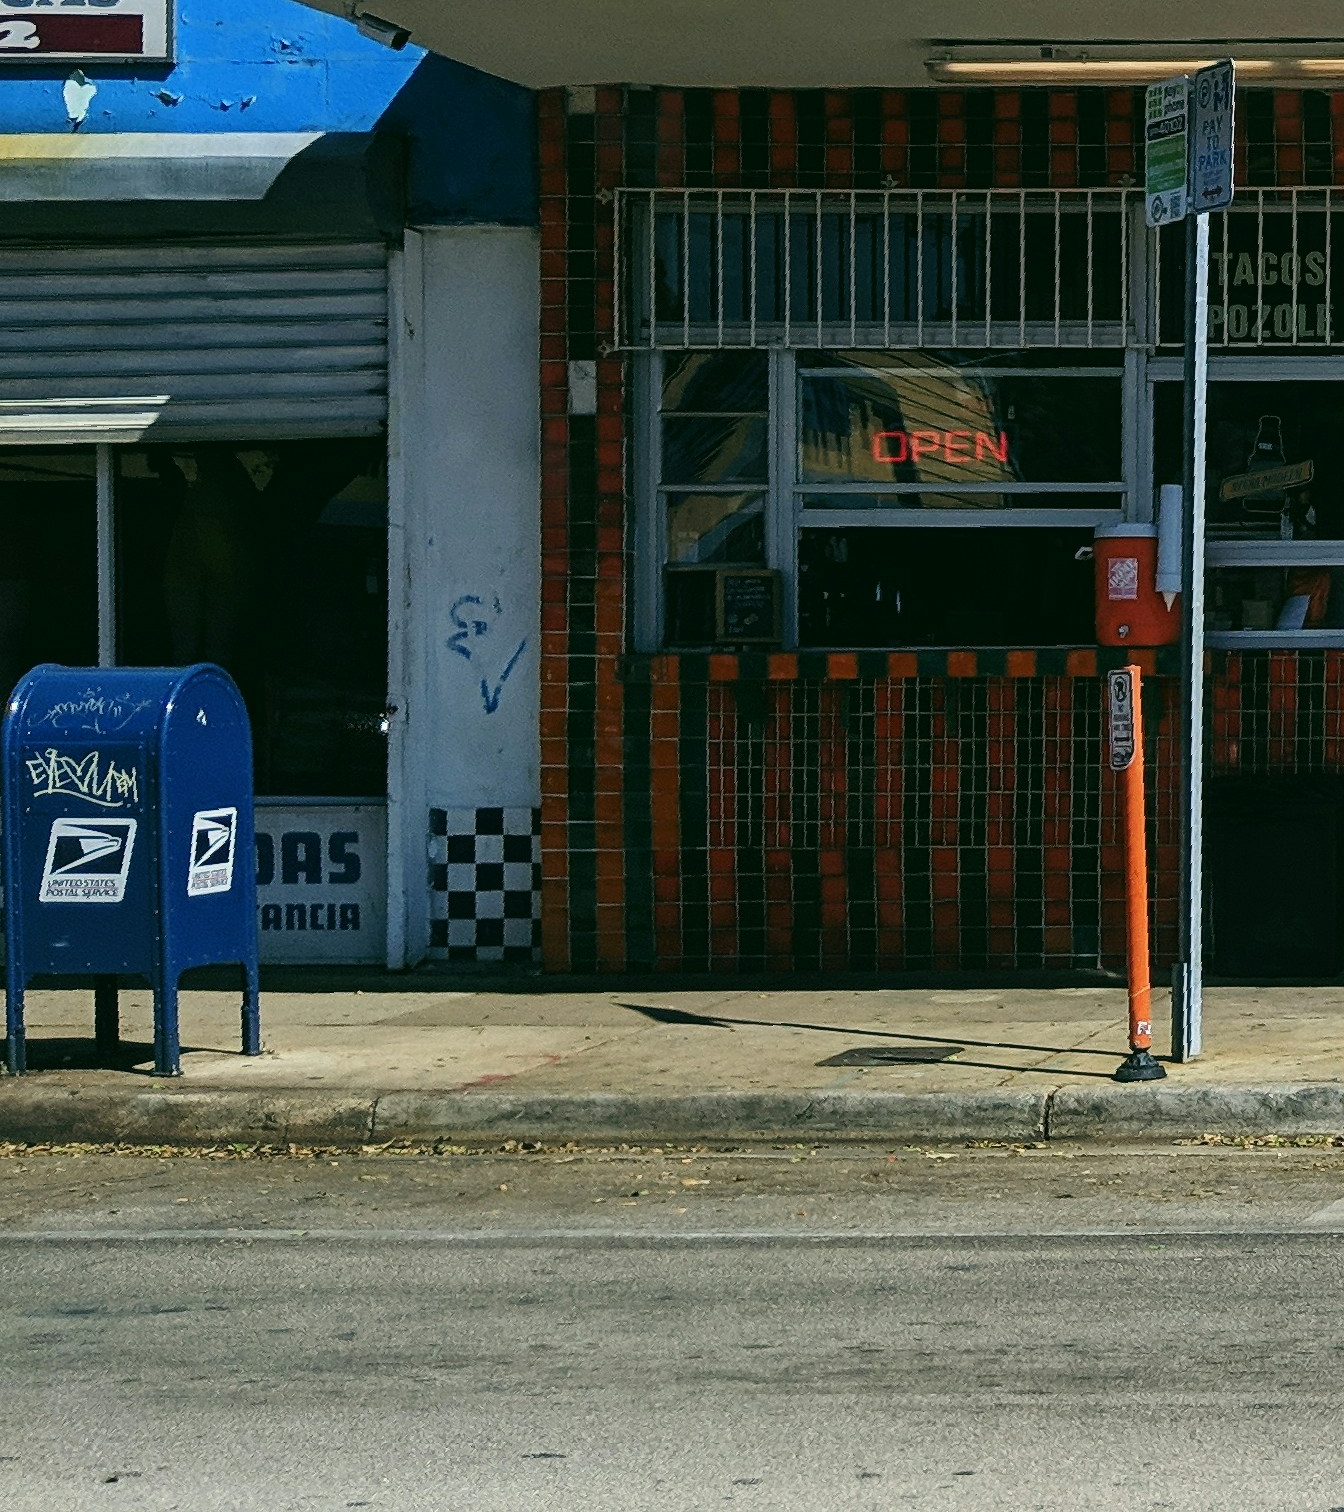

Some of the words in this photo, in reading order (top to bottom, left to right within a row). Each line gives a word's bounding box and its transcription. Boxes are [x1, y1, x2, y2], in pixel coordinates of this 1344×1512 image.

[1202, 115, 1223, 136] PAY
[1198, 149, 1227, 172] PARK
[1211, 250, 1326, 287] TACOS
[1208, 303, 1335, 339] POZOLE
[872, 429, 1010, 465] OPEN
[45, 888, 79, 898] POSTAL
[82, 888, 119, 899] SERVICE
[82, 878, 117, 888] STATES
[256, 903, 361, 931] ANCIA
